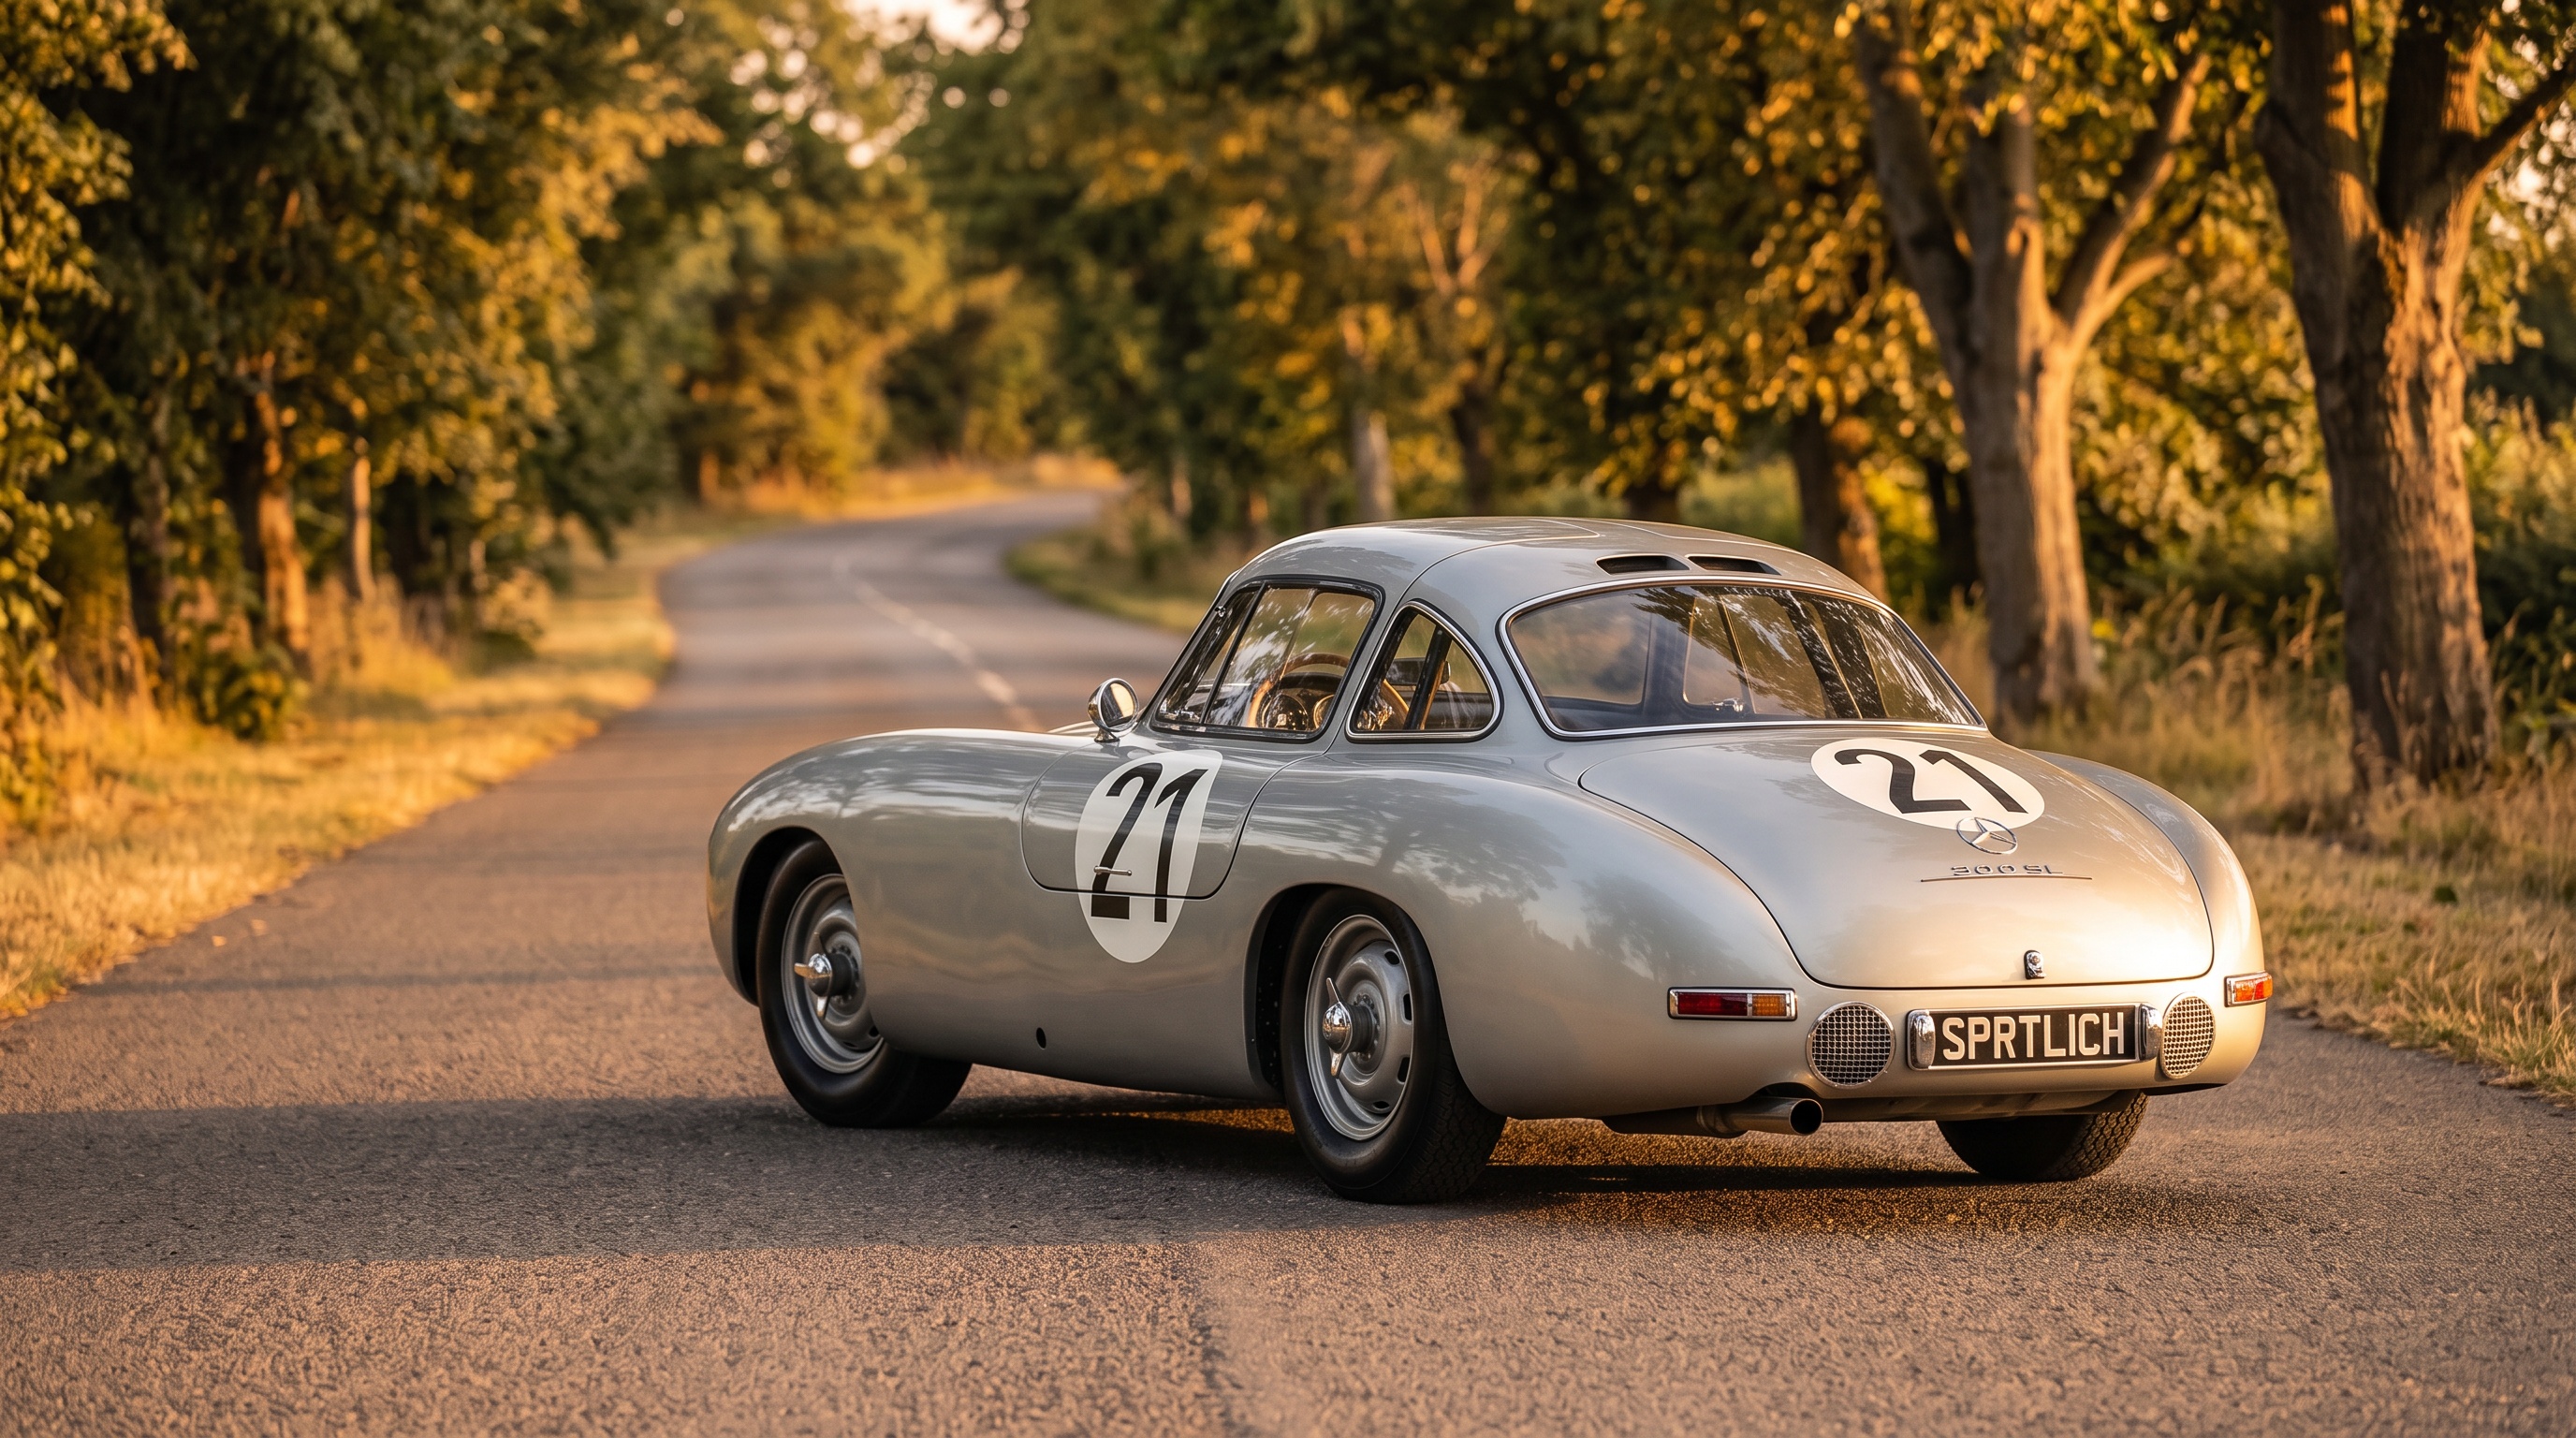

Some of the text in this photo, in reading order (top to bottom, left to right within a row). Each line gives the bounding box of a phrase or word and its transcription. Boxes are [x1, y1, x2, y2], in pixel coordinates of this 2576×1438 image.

[1834, 748, 2029, 814] 21
[1090, 762, 1208, 923] 21
[2023, 864, 2064, 874] SL
[1942, 1011, 2125, 1061] SPRTLICH
